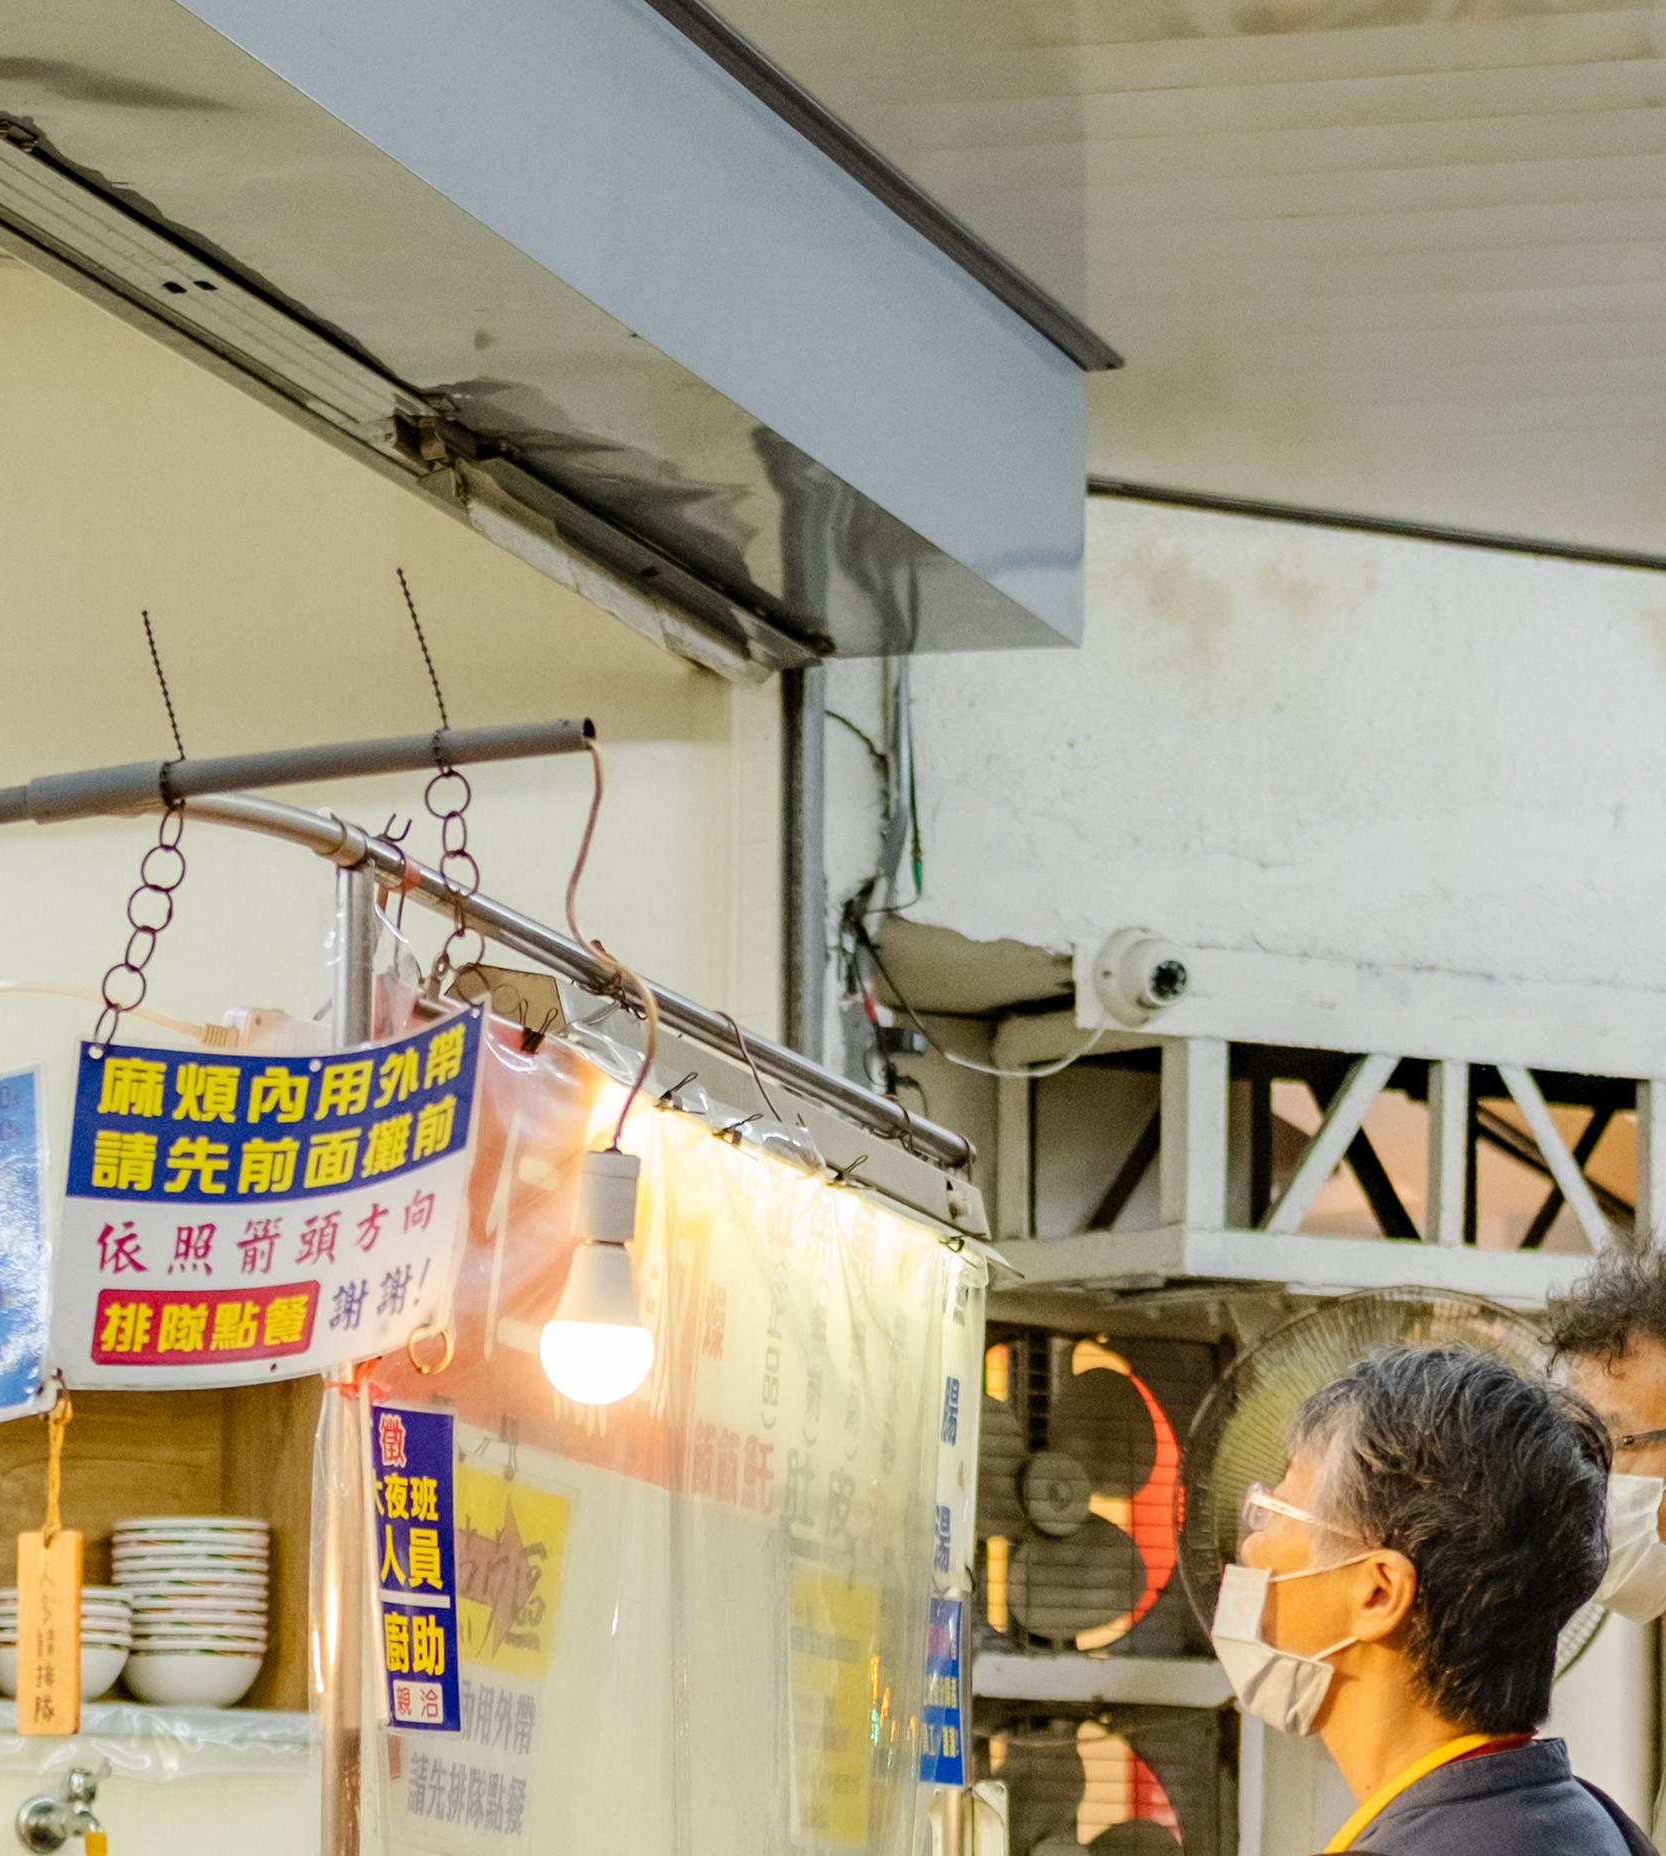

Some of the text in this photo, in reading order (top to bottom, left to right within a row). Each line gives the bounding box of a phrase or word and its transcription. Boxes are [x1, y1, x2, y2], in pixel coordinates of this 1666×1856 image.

[96, 1022, 466, 1124] 麻煩內用外帶
[91, 1093, 457, 1195] 請先前面攤前
[96, 1189, 436, 1276] 依照箭頭方向
[100, 1294, 310, 1354] 排隊點餐
[380, 1528, 443, 1590] 人員
